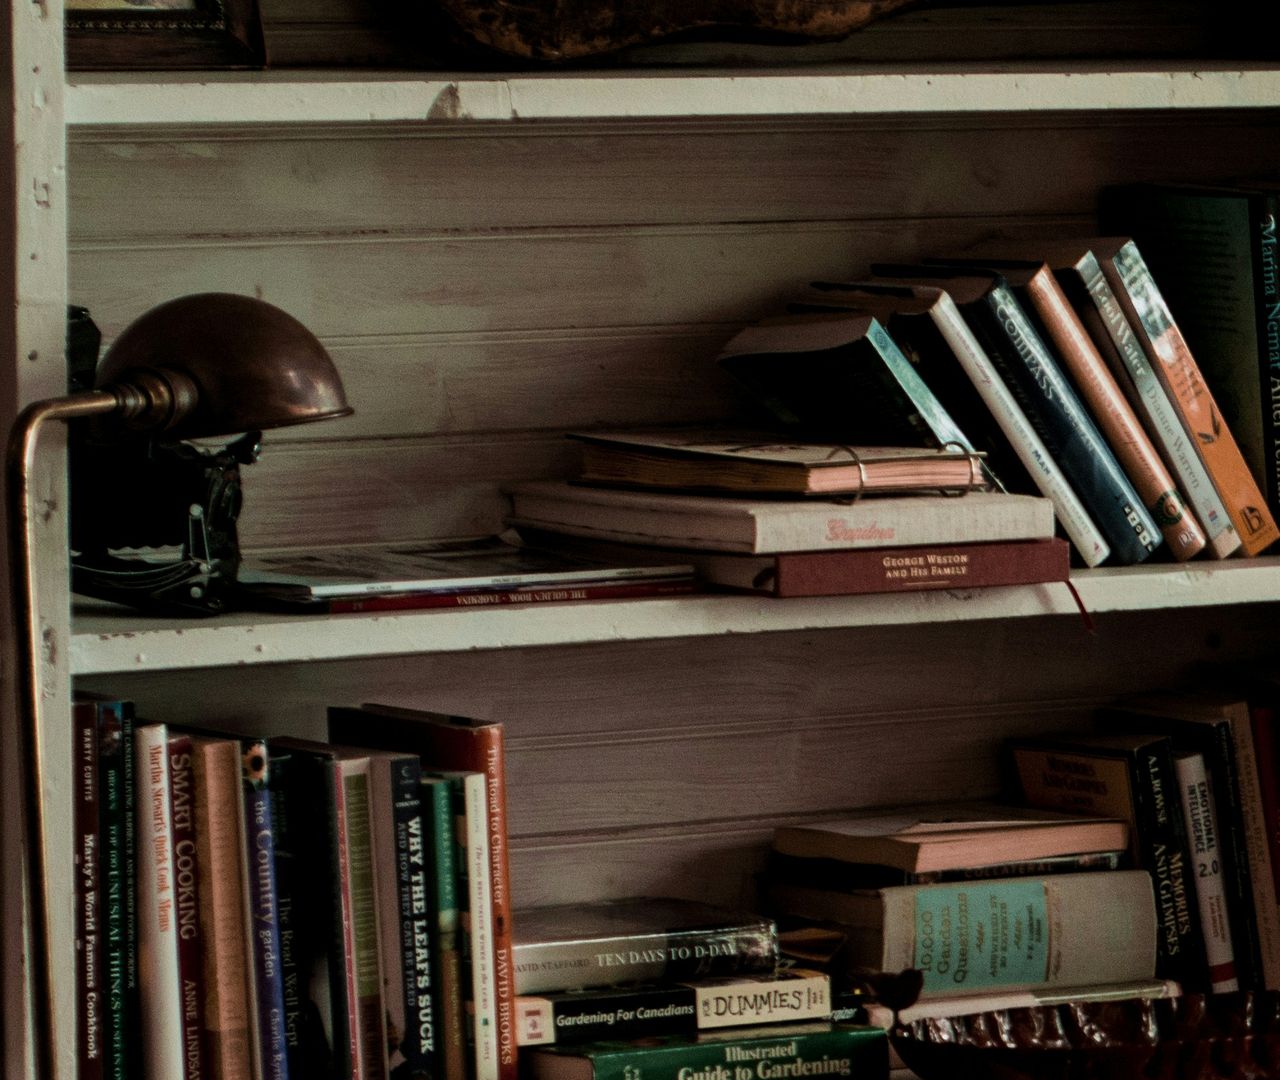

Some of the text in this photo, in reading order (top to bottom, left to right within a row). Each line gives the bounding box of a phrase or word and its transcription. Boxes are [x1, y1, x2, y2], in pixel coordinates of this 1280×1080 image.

[1260, 224, 1279, 297] Marina
[1167, 436, 1207, 489] Warren
[882, 553, 970, 567] GEORGE WESTON
[885, 565, 968, 579] AND HIS FAMILY
[123, 719, 132, 735] THE
[123, 737, 133, 779] CANADIAN
[106, 770, 117, 810] BROWN
[170, 753, 192, 832] SMART
[253, 801, 266, 824] the
[108, 824, 119, 847] TOP
[148, 745, 172, 933] Martha Stewart's Quick Cook Menus
[407, 815, 425, 867] WHY
[440, 791, 453, 869] ELIZABETH
[1187, 784, 1205, 854] INTELLIGENCE
[1198, 782, 1216, 853] EMOTIONAL
[109, 850, 119, 869] 100
[253, 829, 275, 925] Country
[1199, 860, 1219, 878] 2.0
[82, 728, 99, 1060] MARTY CURTIS Marty's World Famous Cookbook
[107, 870, 121, 947] UNUSUAL
[174, 839, 197, 941] COOKING
[396, 822, 416, 1008] AND HOW THEY CAN BE FIXED
[410, 870, 428, 915] THE
[487, 746, 513, 1065] The Road to Character DAVID BROOKS
[1151, 843, 1180, 956] AND GLIMPSES
[1167, 852, 1190, 936] MEMORIES
[259, 929, 276, 977] garden
[413, 919, 432, 990] LEAFS
[515, 963, 539, 973] AVID
[595, 953, 626, 968] TEN
[629, 950, 666, 965] DAYS
[669, 947, 690, 961] TO
[695, 942, 738, 959] D-DAY
[937, 906, 951, 975] Garden
[953, 892, 968, 983] Questions
[109, 951, 122, 1010] THINGS
[127, 943, 136, 990] COOKBOOK
[278, 894, 301, 1049] The Road Well Kept
[111, 1013, 122, 1028] TO
[183, 979, 198, 1021] ANNE
[417, 994, 435, 1055] SUCK
[556, 989, 803, 1027] Gardening For Canadians DUMMIES
[112, 1031, 122, 1050] SEE
[268, 1008, 281, 1050] Charlie
[725, 1041, 798, 1063] Illustrated
[112, 1053, 122, 1065] IN
[733, 1065, 753, 1080] to
[756, 1055, 851, 1080] Gardening
